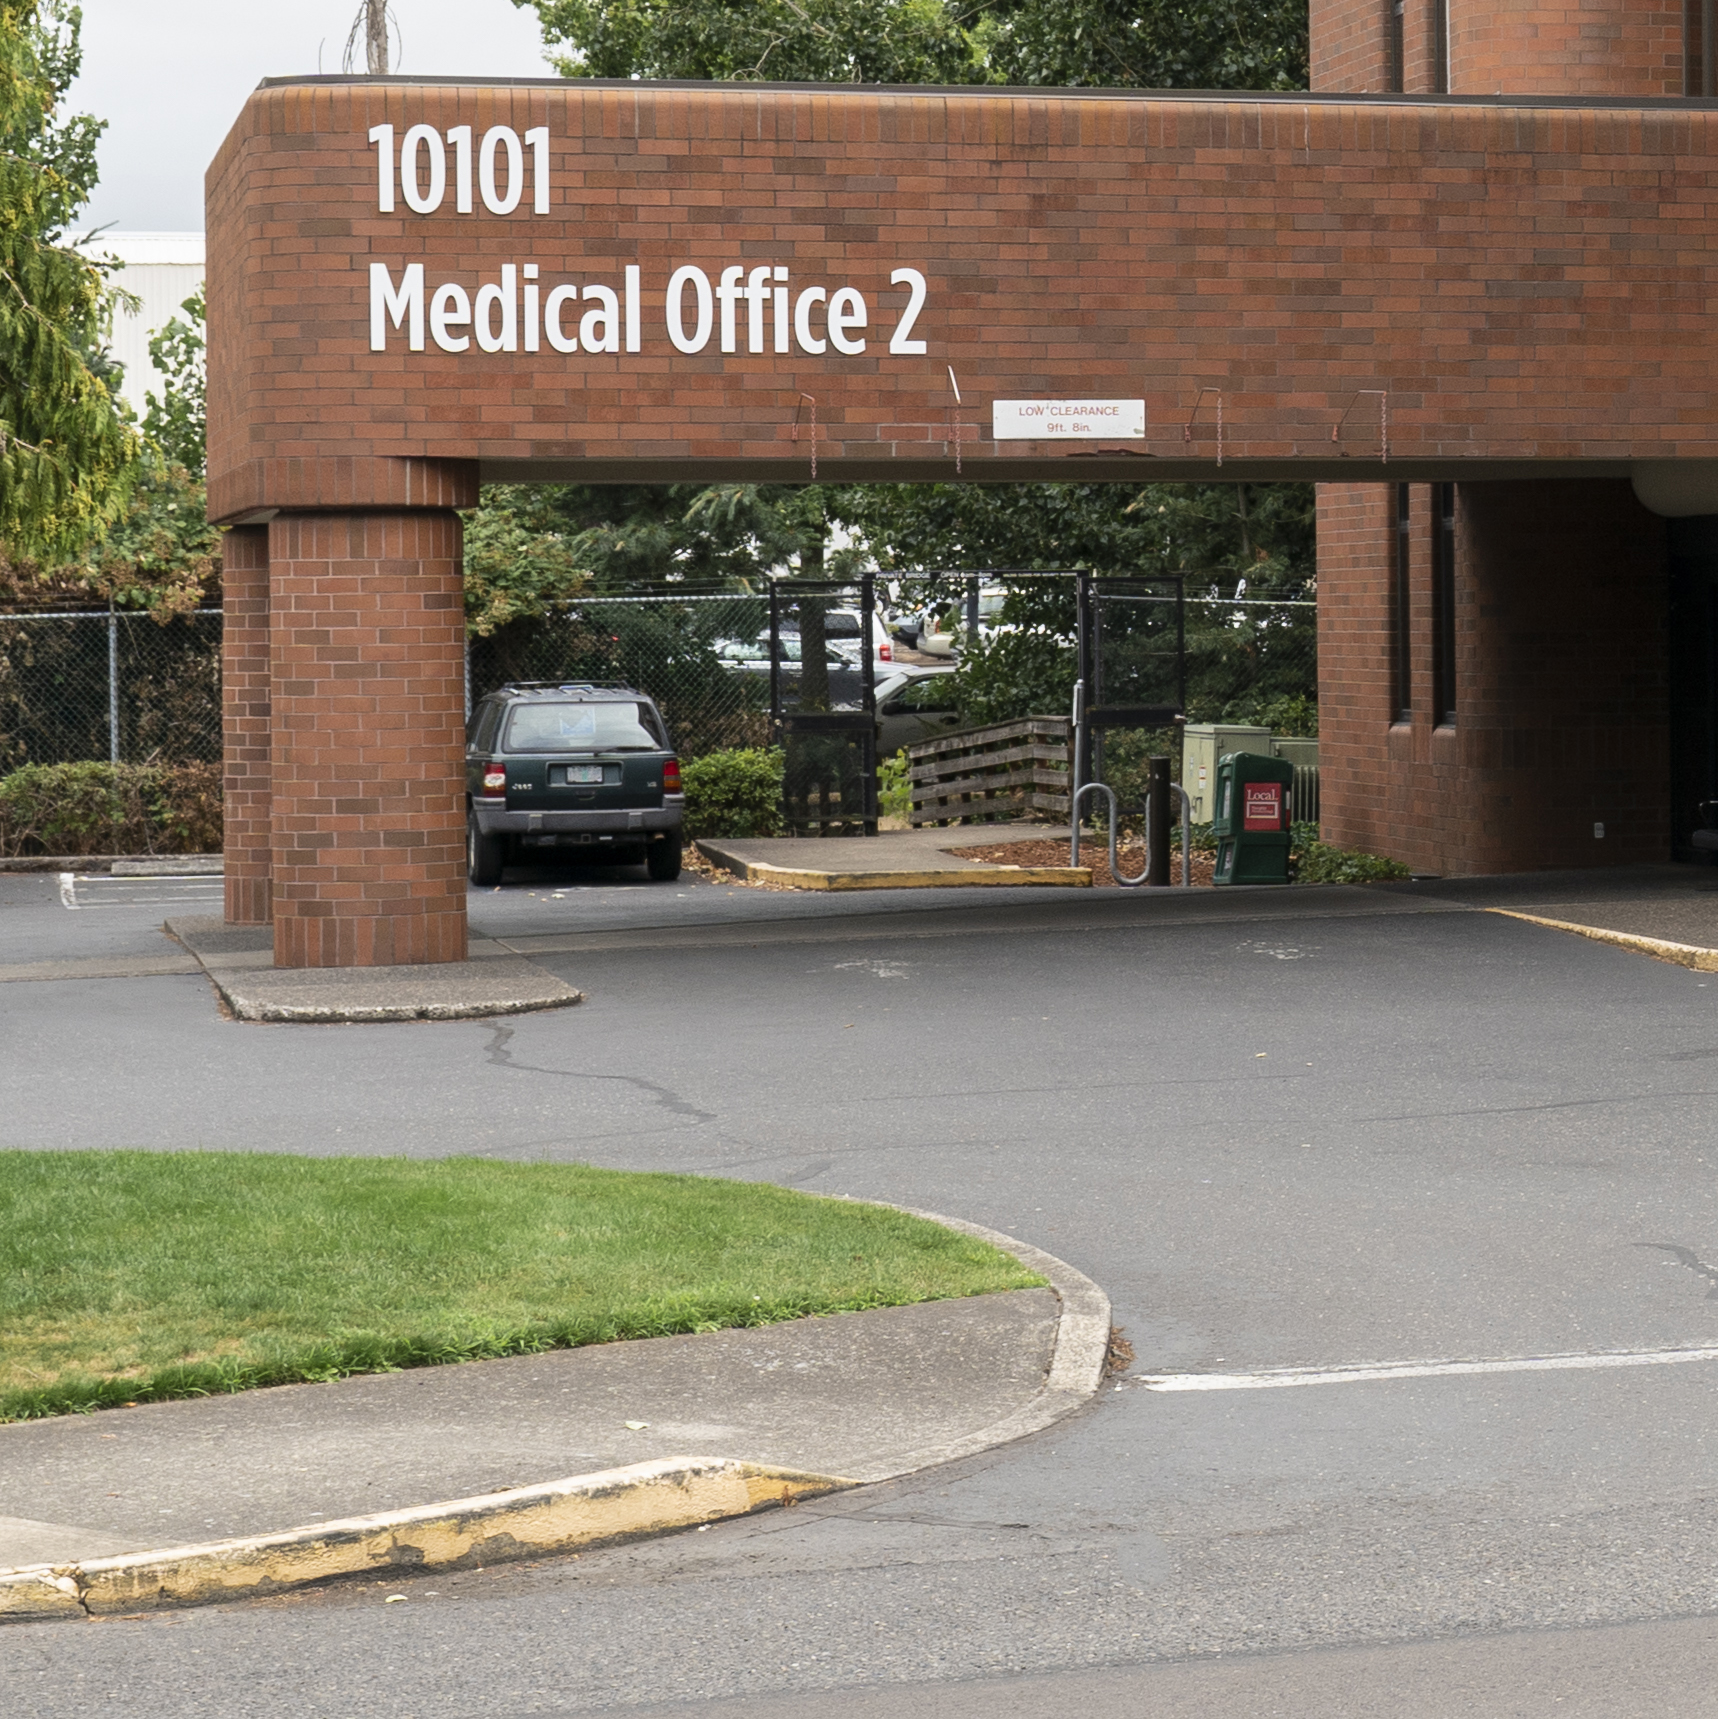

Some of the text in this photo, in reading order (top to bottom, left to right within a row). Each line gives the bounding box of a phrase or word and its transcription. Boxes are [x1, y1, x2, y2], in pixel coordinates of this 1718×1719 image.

[368, 124, 550, 214] 10101
[369, 263, 928, 355] Medical Office 2
[1019, 406, 1120, 416] LOW CLEARANCE
[1046, 422, 1092, 432] 9ft. 8in.
